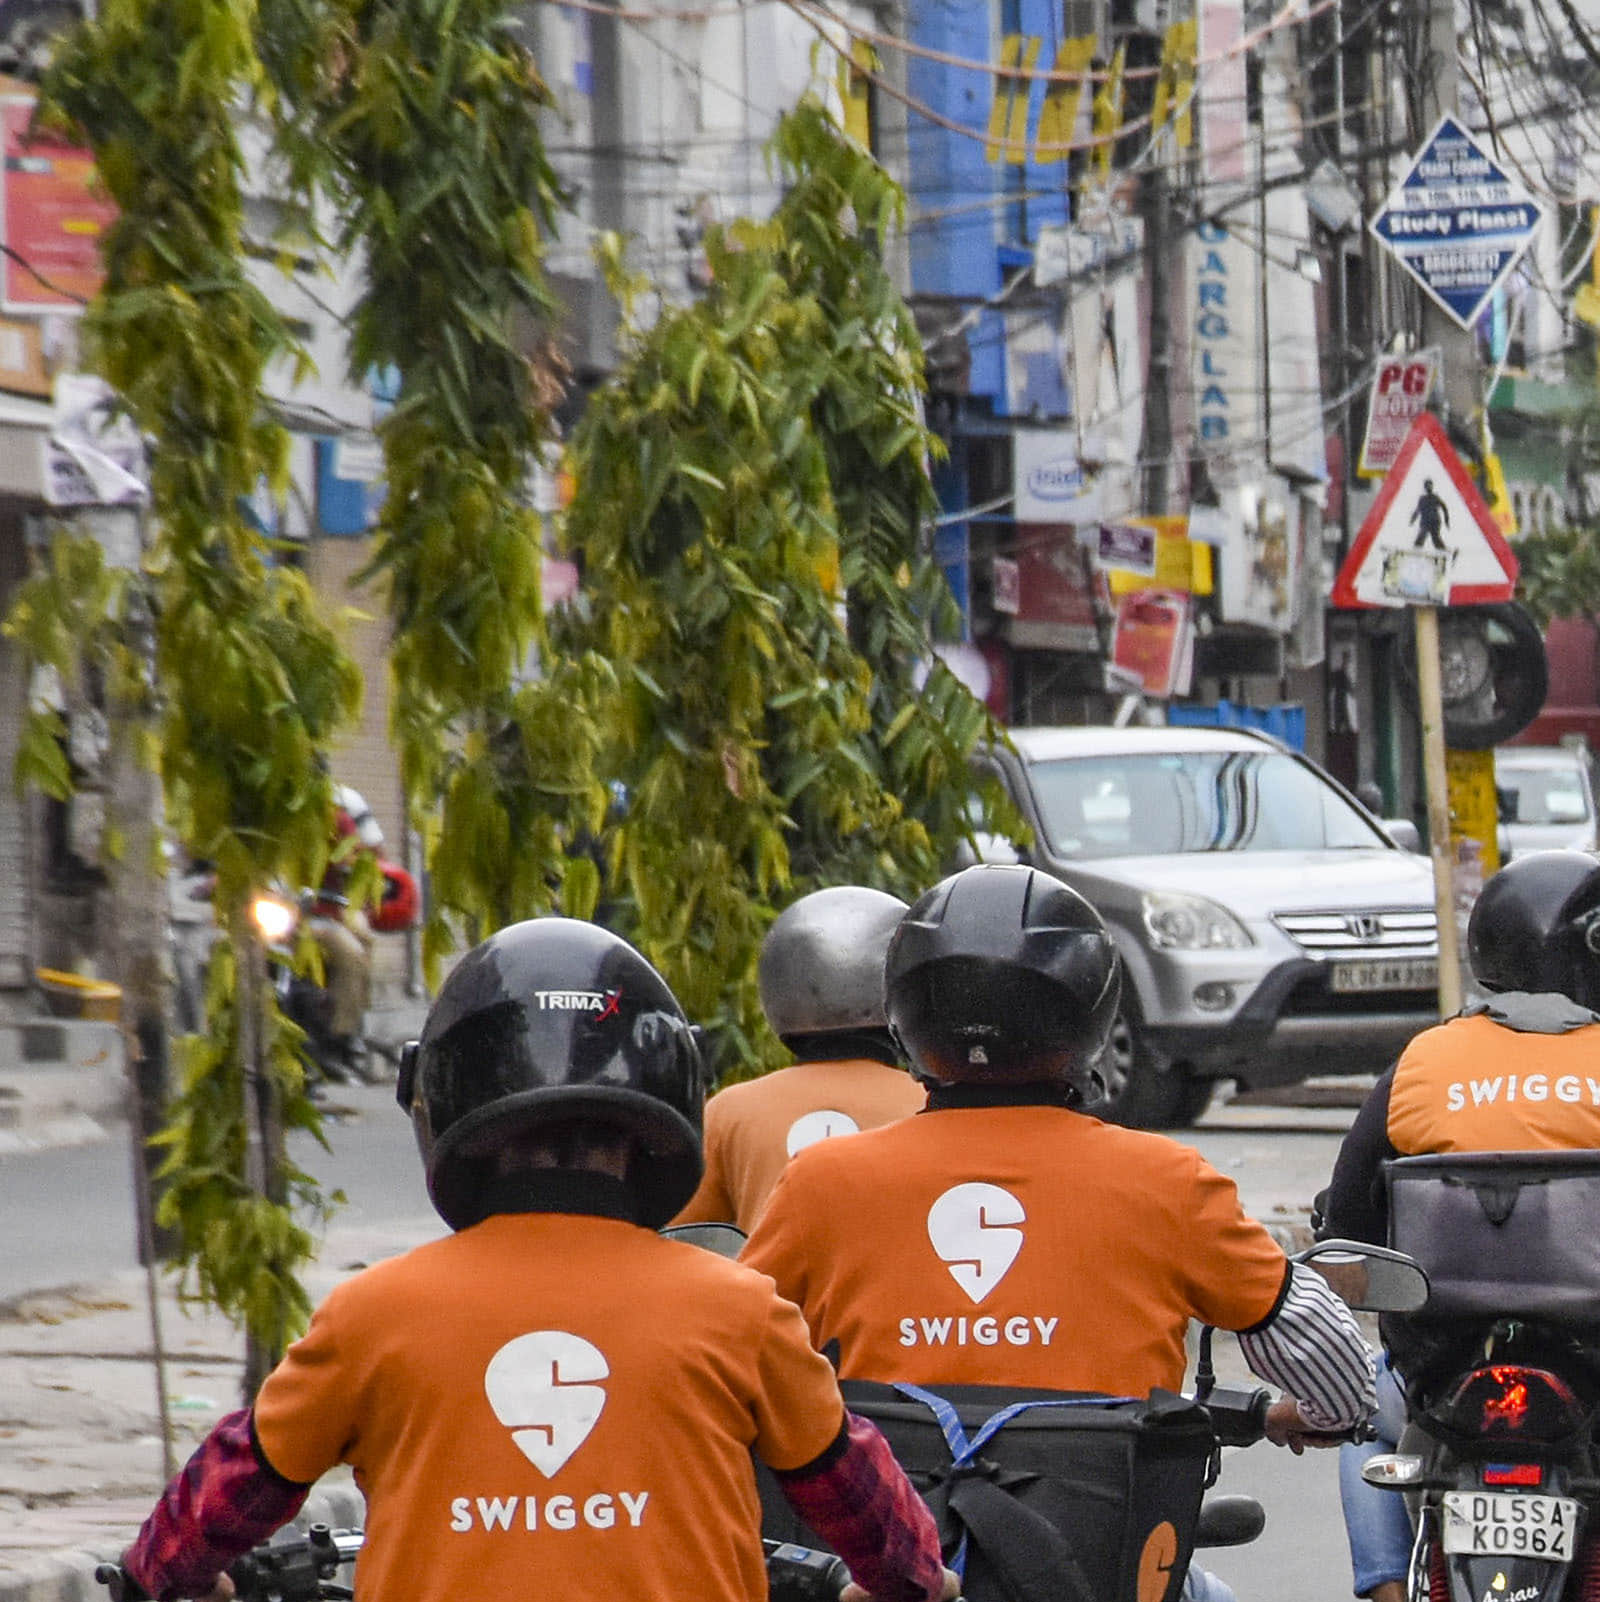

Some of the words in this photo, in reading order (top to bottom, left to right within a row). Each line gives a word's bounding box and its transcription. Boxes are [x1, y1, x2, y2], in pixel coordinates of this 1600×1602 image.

[1390, 214, 1451, 235] Study
[1457, 207, 1529, 230] Planet
[1379, 364, 1427, 394] PG
[534, 987, 624, 1022] TRIMAX
[899, 1316, 1058, 1346] SWIGGY
[450, 1492, 649, 1532] SWIGGY
[1472, 1497, 1564, 1527] DL5SA
